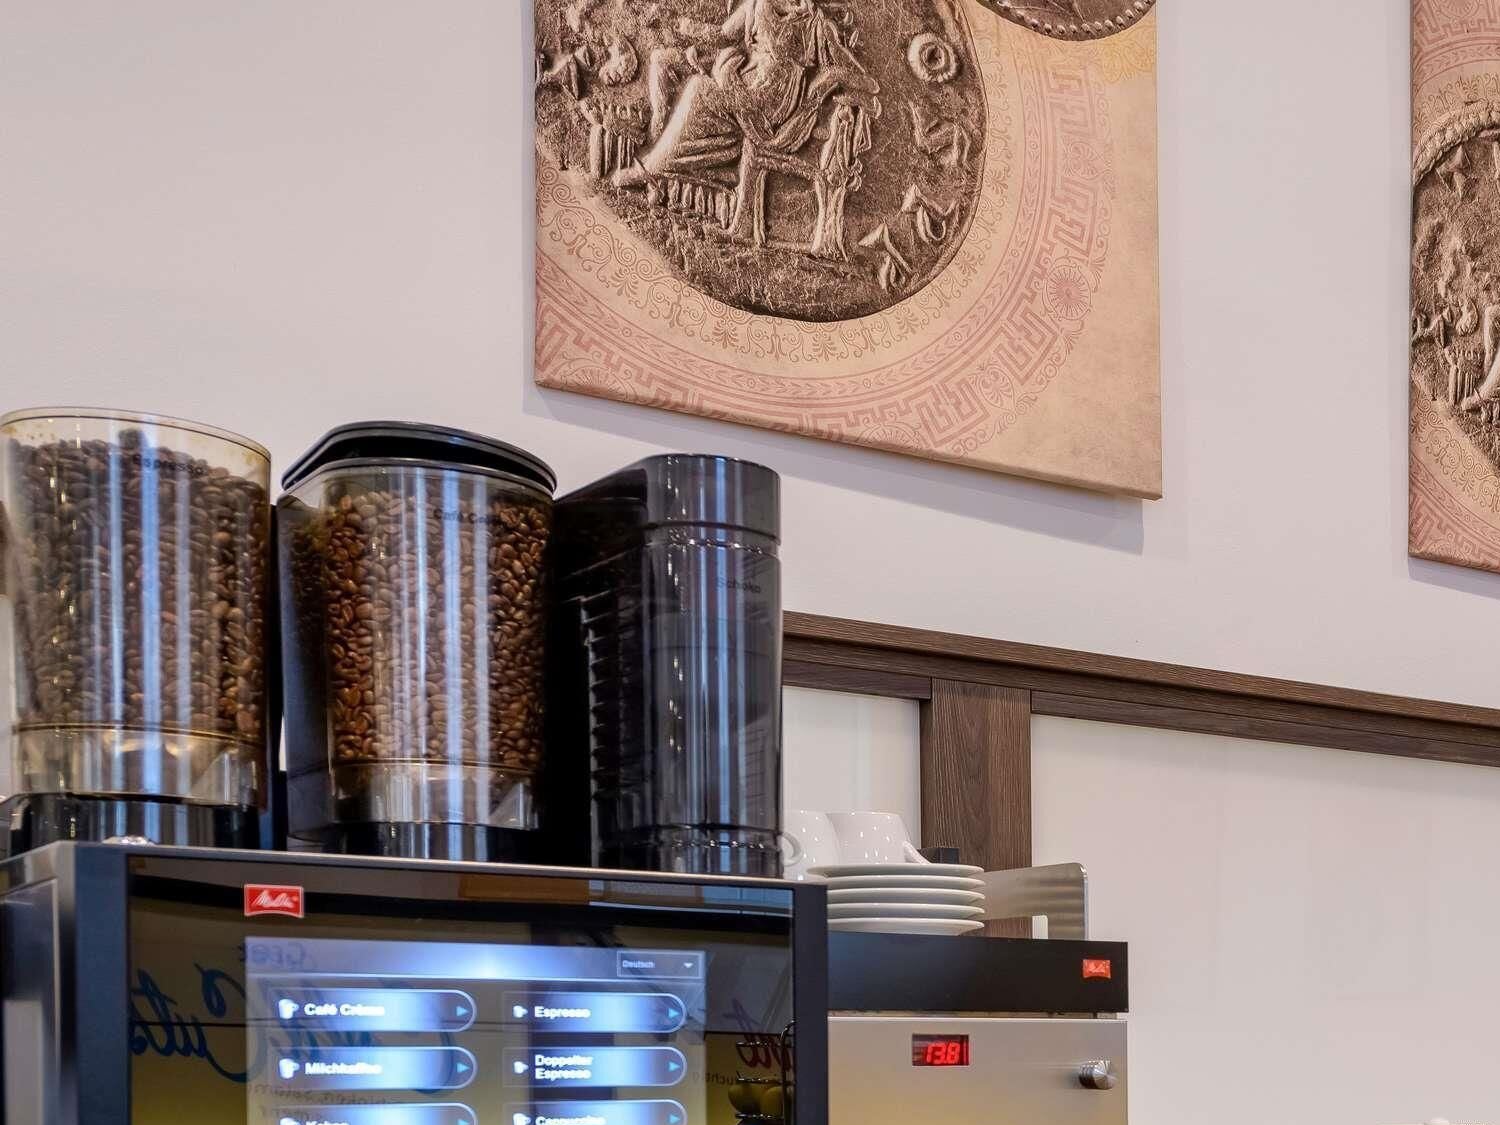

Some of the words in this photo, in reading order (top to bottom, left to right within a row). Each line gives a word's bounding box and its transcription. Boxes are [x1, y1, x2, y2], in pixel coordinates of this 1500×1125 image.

[303, 1003, 338, 1016] Café
[534, 1006, 591, 1019] Espresso
[534, 1054, 593, 1068] Doppelter
[304, 1062, 383, 1075] Milchkaffee
[534, 1067, 592, 1081] Espresso
